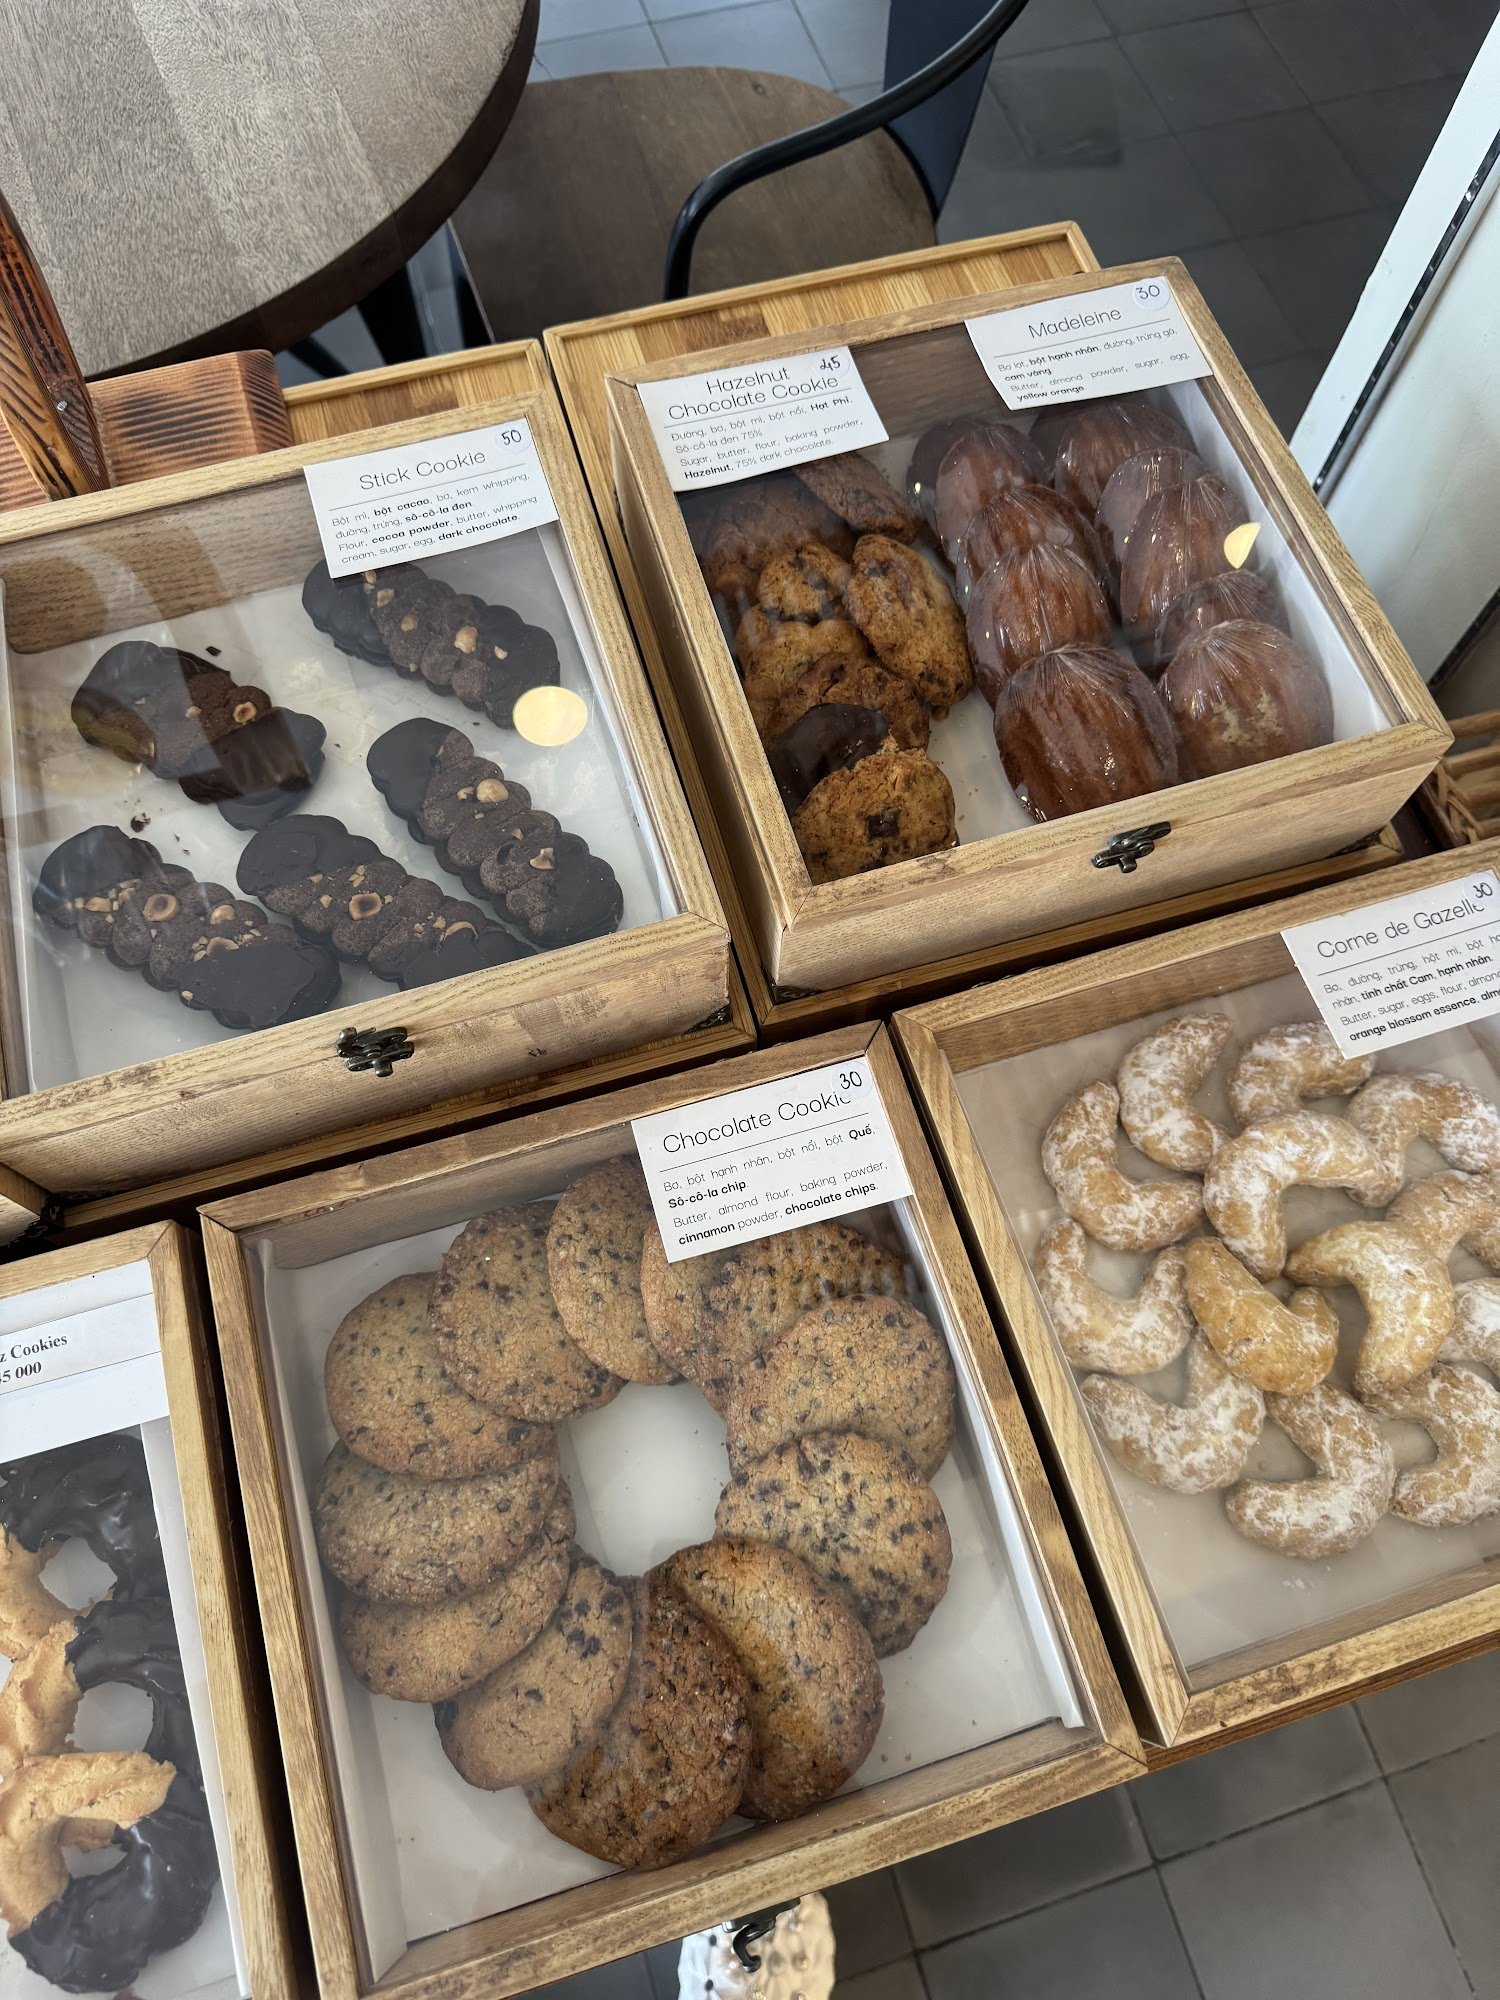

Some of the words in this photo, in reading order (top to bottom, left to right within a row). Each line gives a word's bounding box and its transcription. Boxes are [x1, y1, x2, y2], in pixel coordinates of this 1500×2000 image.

[1136, 285, 1160, 299] 30
[1029, 309, 1122, 339] Madeleine
[820, 356, 840, 370] 45
[1029, 356, 1047, 366] bột
[1048, 350, 1073, 362] hạnh
[706, 367, 790, 395] Hazelnut
[1005, 373, 1025, 382] cam
[1011, 383, 1042, 392] Butter,
[1050, 374, 1082, 386] almond
[1090, 366, 1128, 379] powder,
[1135, 358, 1163, 369] sugar,
[669, 391, 766, 420] Chocolate
[772, 376, 839, 399] Cookie
[1017, 391, 1048, 402] yellow
[730, 419, 746, 429] bột
[769, 411, 785, 422] bột
[502, 429, 521, 446] 50
[680, 456, 712, 467] Sugar,
[717, 446, 749, 460] butter,
[755, 440, 780, 450] flour,
[785, 430, 818, 443] baking
[824, 420, 863, 435] powder,
[721, 434, 739, 445] đen
[742, 430, 763, 440] 75%
[360, 468, 411, 490] Stick
[416, 450, 486, 477] Cookie
[684, 463, 733, 480] Hazelnut,
[735, 457, 757, 470] 75%
[760, 450, 782, 463] dark
[784, 438, 834, 456] chocolate.
[332, 517, 350, 527] Bột
[355, 512, 369, 521] mì,
[374, 507, 392, 516] bột
[397, 497, 433, 511] cacao,
[457, 487, 479, 497] kem
[483, 472, 530, 490] whipping,
[339, 540, 367, 551] Flour,
[372, 532, 405, 544] cocoa
[409, 521, 453, 537] powder,
[456, 511, 489, 524] butter,
[493, 496, 537, 513] whipping
[405, 507, 449, 523] sô-cô-la
[342, 552, 376, 564] cream,
[380, 543, 411, 555] sugar,
[414, 537, 436, 548] egg,
[438, 530, 463, 541] dark
[466, 516, 520, 534] chocolate.
[1473, 883, 1493, 898] 30
[1317, 932, 1378, 958] Corne
[1385, 922, 1410, 939] de
[1466, 939, 1484, 950] bột
[1361, 988, 1382, 1000] tinh
[1384, 980, 1408, 993] chất
[1409, 973, 1436, 985] Cam,
[1437, 963, 1465, 977] hạnh
[1340, 1011, 1376, 1026] Butter,
[1378, 1001, 1409, 1016] sugar,
[1411, 992, 1439, 1005] eggs,
[1441, 982, 1466, 995] flour,
[1350, 1025, 1387, 1041] orange
[1388, 1010, 1431, 1028] blossom
[1434, 996, 1480, 1015] essence,
[839, 1071, 862, 1089] 30
[663, 1112, 772, 1153] Chocolate
[664, 1179, 682, 1192] Bơ,
[687, 1173, 706, 1186] bột
[711, 1165, 738, 1179] hạnh
[744, 1156, 772, 1170] nhân,
[778, 1149, 796, 1160] bột
[801, 1140, 820, 1153] nổi,
[825, 1134, 843, 1147] bột
[849, 1123, 875, 1140] Quế,
[669, 1188, 718, 1208] Sô-cô-la
[721, 1181, 749, 1196] chip.
[674, 1210, 711, 1227] Butter,
[719, 1197, 758, 1215] almond
[766, 1187, 793, 1202] flour,
[800, 1176, 836, 1192] baking
[843, 1161, 888, 1181] powder,
[679, 1223, 735, 1245] cinnamon
[737, 1210, 783, 1231] powder,
[785, 1193, 842, 1215] chocolate
[846, 1183, 878, 1197] chips.
[11, 1336, 68, 1358] Cookies
[16, 1362, 41, 1378] 000
